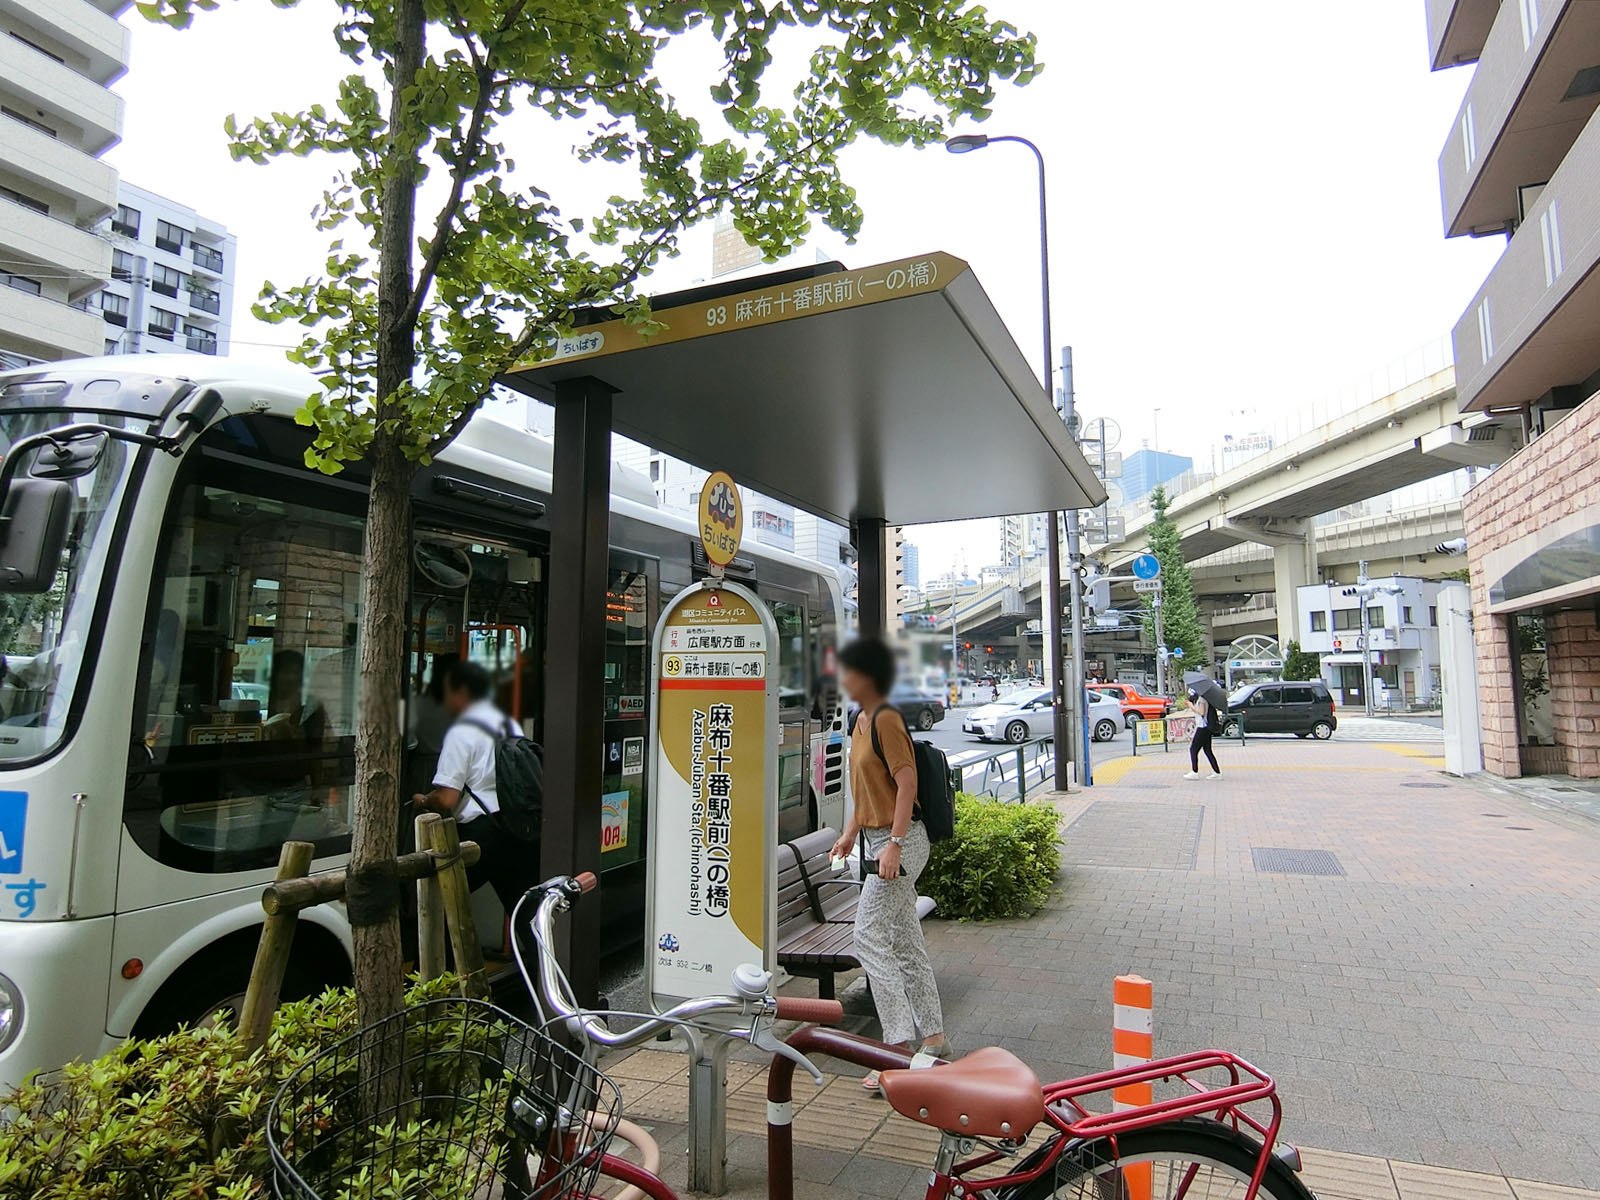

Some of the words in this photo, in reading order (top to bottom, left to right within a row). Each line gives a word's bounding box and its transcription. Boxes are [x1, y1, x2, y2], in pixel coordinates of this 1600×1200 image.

[706, 305, 728, 327] 93
[735, 260, 938, 323] 麻布十番駅前(一の橋)
[670, 630, 679, 648] 行先
[687, 635, 746, 649] 広尾駅方面
[667, 660, 680, 672] 93
[684, 661, 762, 677] 麻布十番駅前(一の橋)
[627, 699, 643, 707] AED
[704, 703, 733, 918] 麻布十番駅前(一の橋)
[601, 825, 620, 847] 0円
